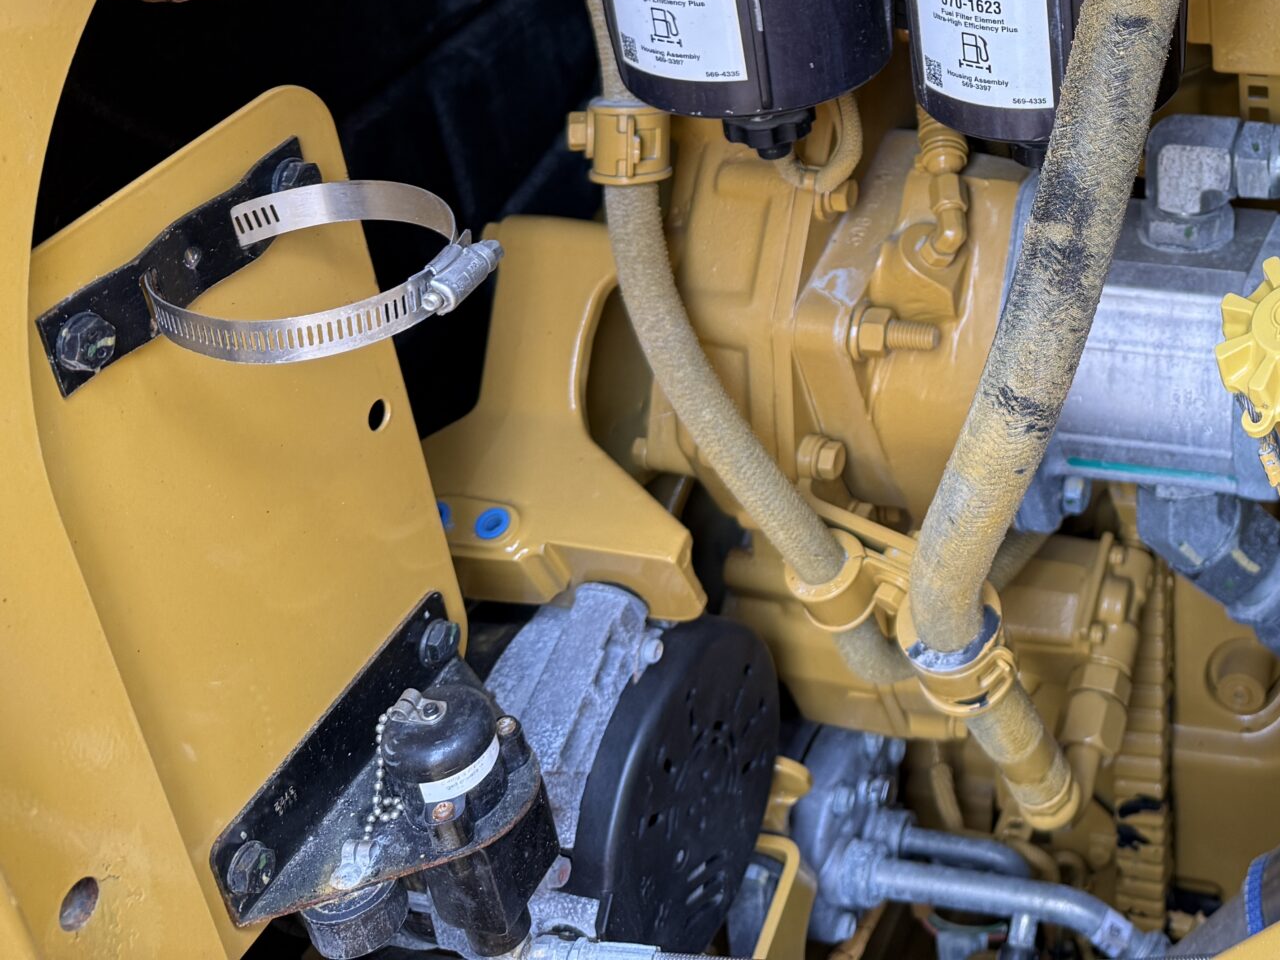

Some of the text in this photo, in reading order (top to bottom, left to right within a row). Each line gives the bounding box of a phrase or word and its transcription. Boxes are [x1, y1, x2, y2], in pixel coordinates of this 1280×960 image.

[941, 7, 1005, 25] Fuel Filter Element
[964, 21, 999, 33] Efficiency
[667, 51, 700, 61] Assembly
[947, 69, 1009, 87] Housing Assembly
